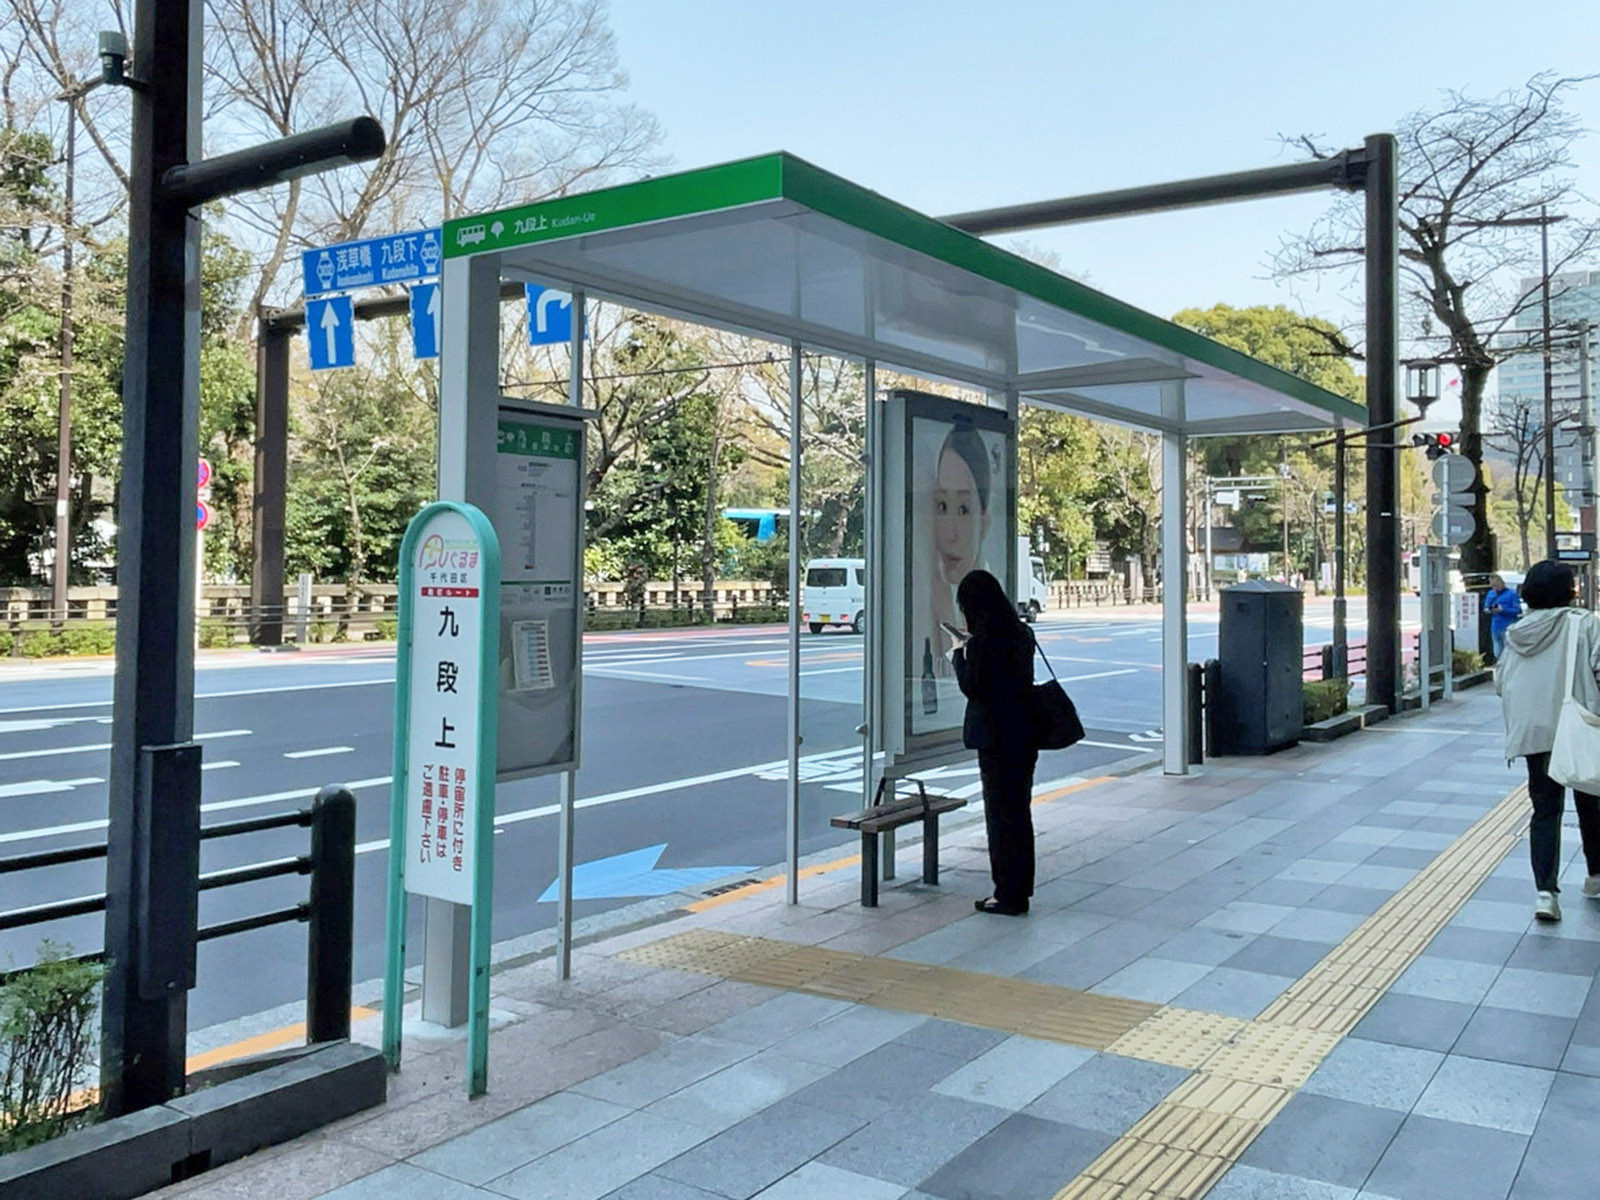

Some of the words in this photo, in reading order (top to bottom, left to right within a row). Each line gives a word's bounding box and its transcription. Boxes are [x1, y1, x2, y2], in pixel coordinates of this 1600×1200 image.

[381, 236, 417, 265] 九段下
[513, 214, 547, 235] 九段上
[551, 212, 596, 228] Kudan-Ue
[430, 572, 468, 584] 千代田区
[434, 606, 459, 748] 九段上
[420, 764, 434, 864] ご遠慮下さい
[436, 765, 449, 858] 駐車・停車は
[452, 767, 466, 872] 停留所に付き
